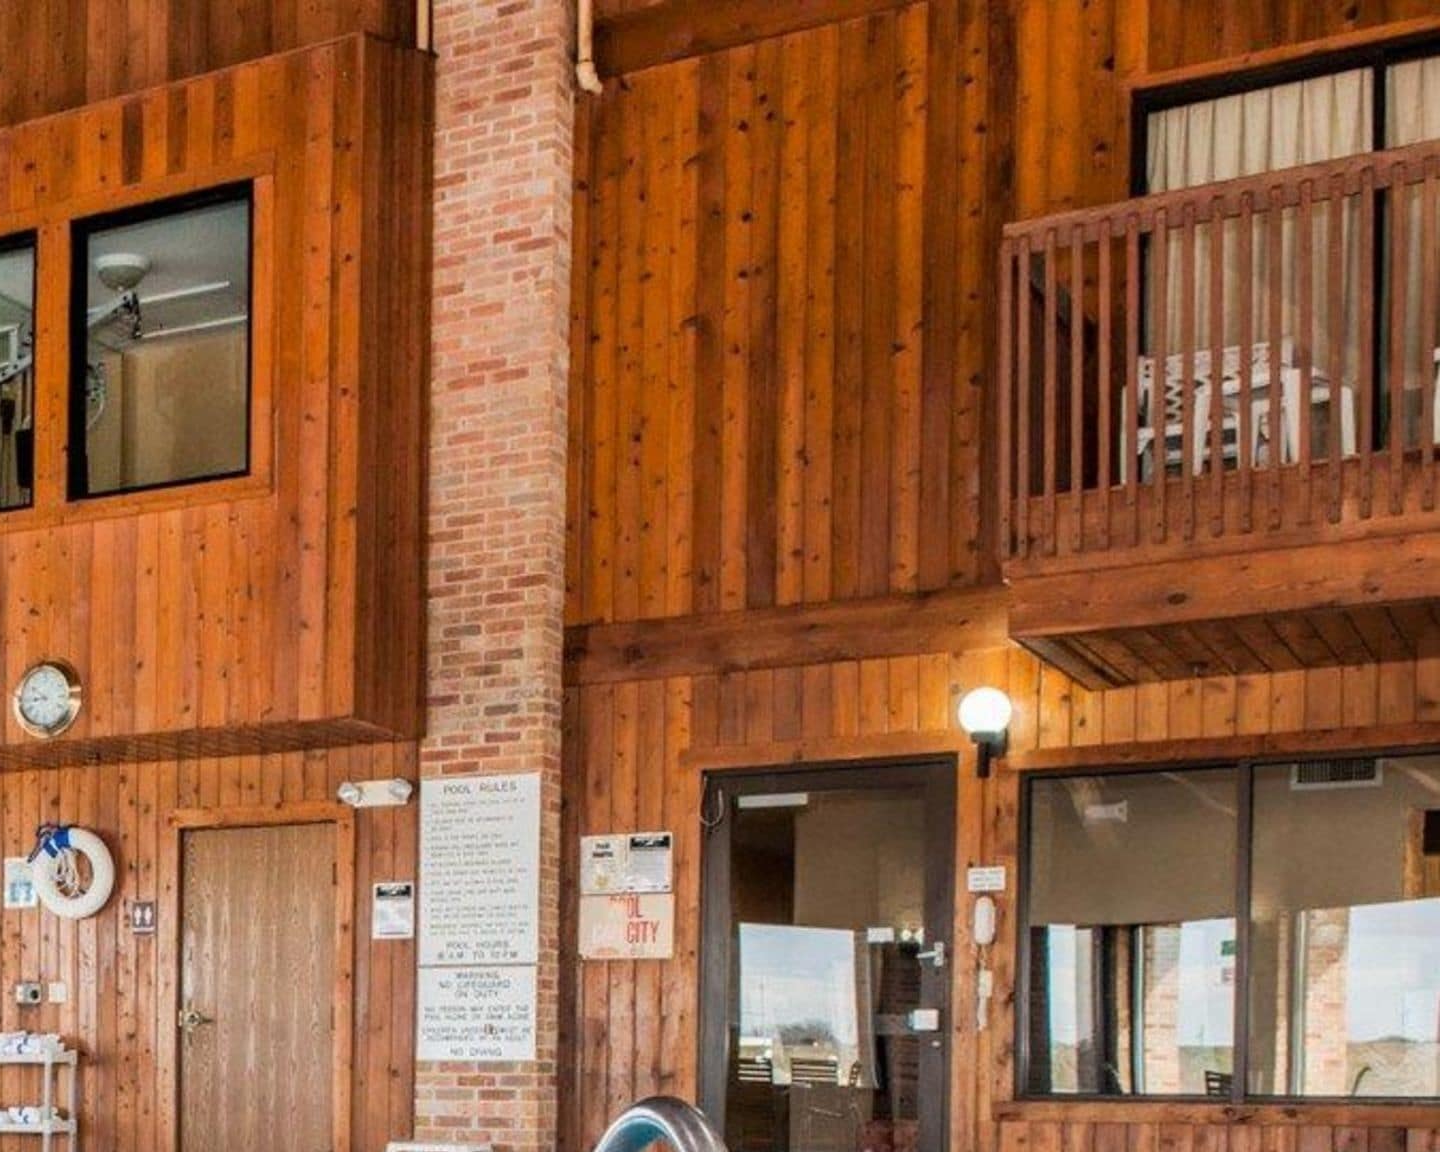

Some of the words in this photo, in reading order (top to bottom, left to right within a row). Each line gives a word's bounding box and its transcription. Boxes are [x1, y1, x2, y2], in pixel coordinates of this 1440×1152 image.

[443, 784, 471, 795] POOL
[479, 781, 518, 793] RULES
[626, 920, 660, 944] CITY
